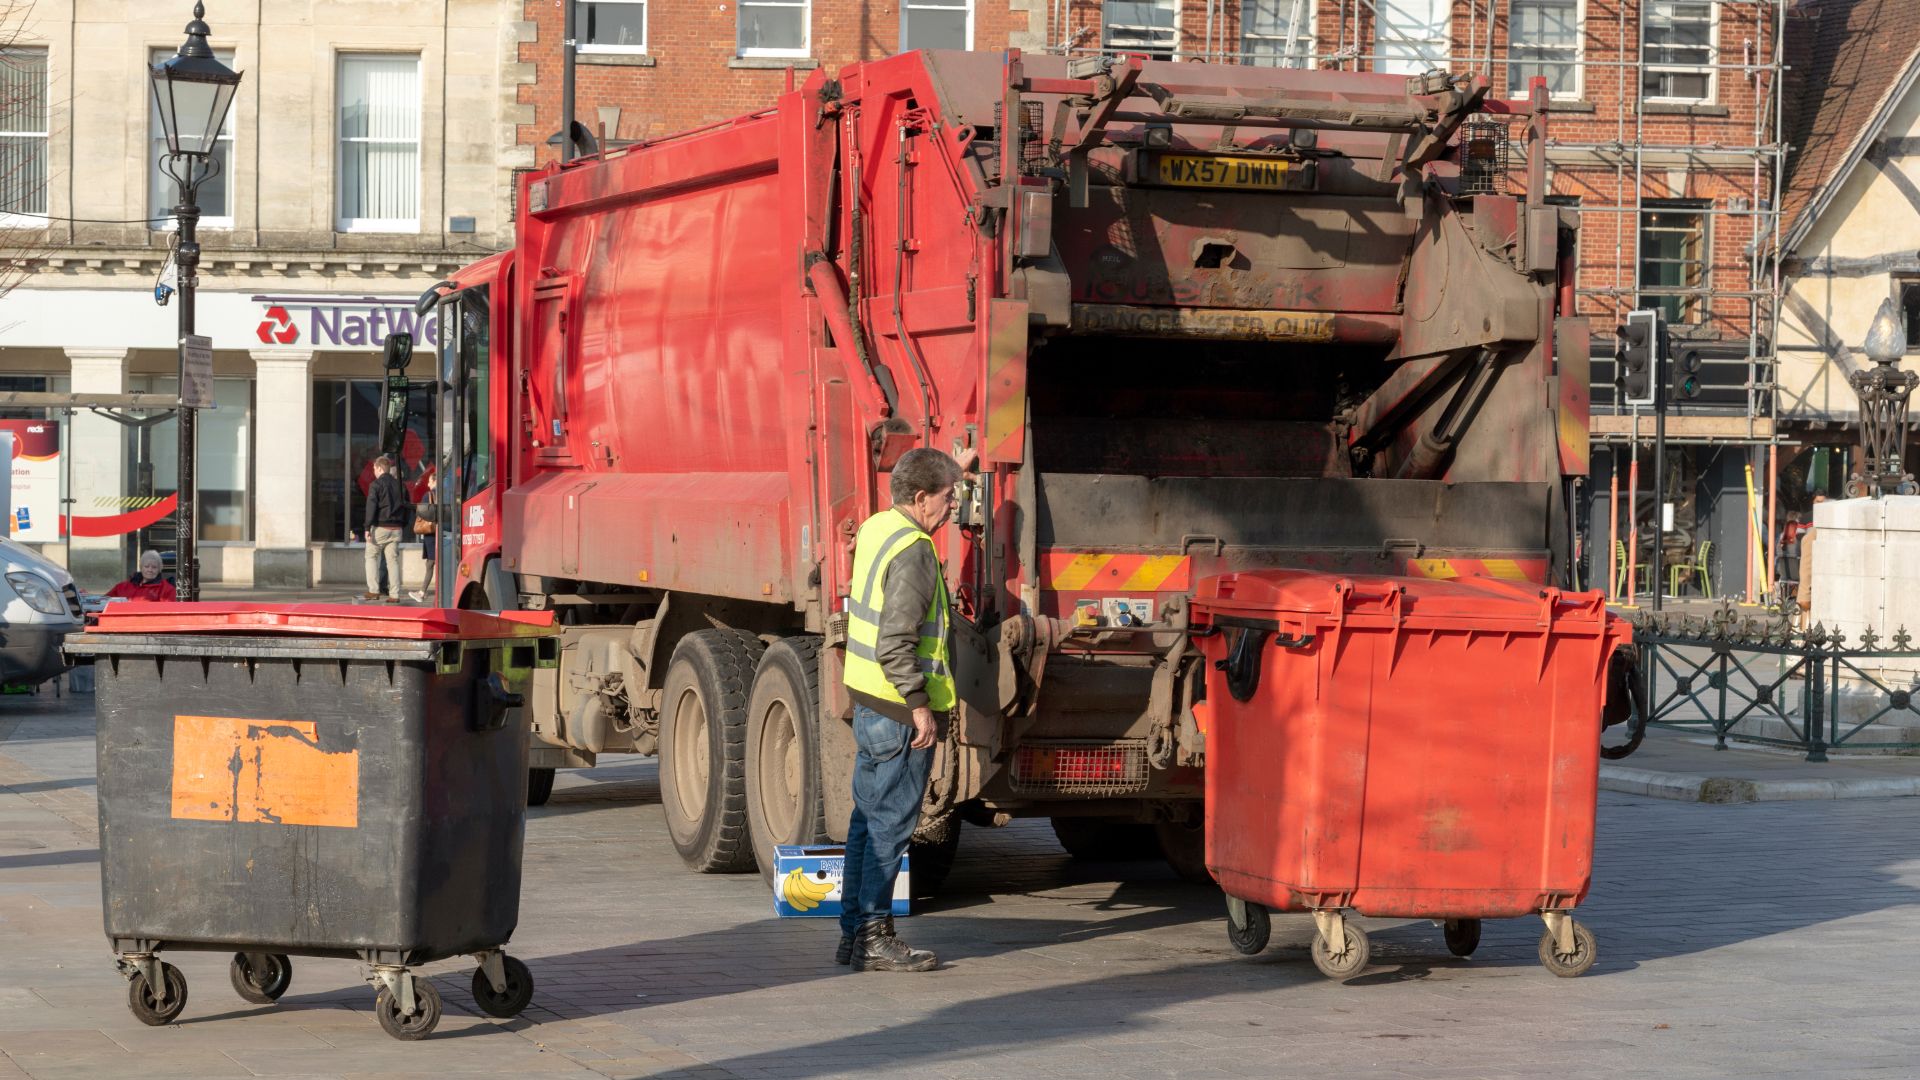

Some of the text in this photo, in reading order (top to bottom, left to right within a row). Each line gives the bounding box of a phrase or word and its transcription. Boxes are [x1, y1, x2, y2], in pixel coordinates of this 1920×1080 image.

[1170, 159, 1278, 185] WX57 DWN
[1273, 316, 1323, 335] OUT
